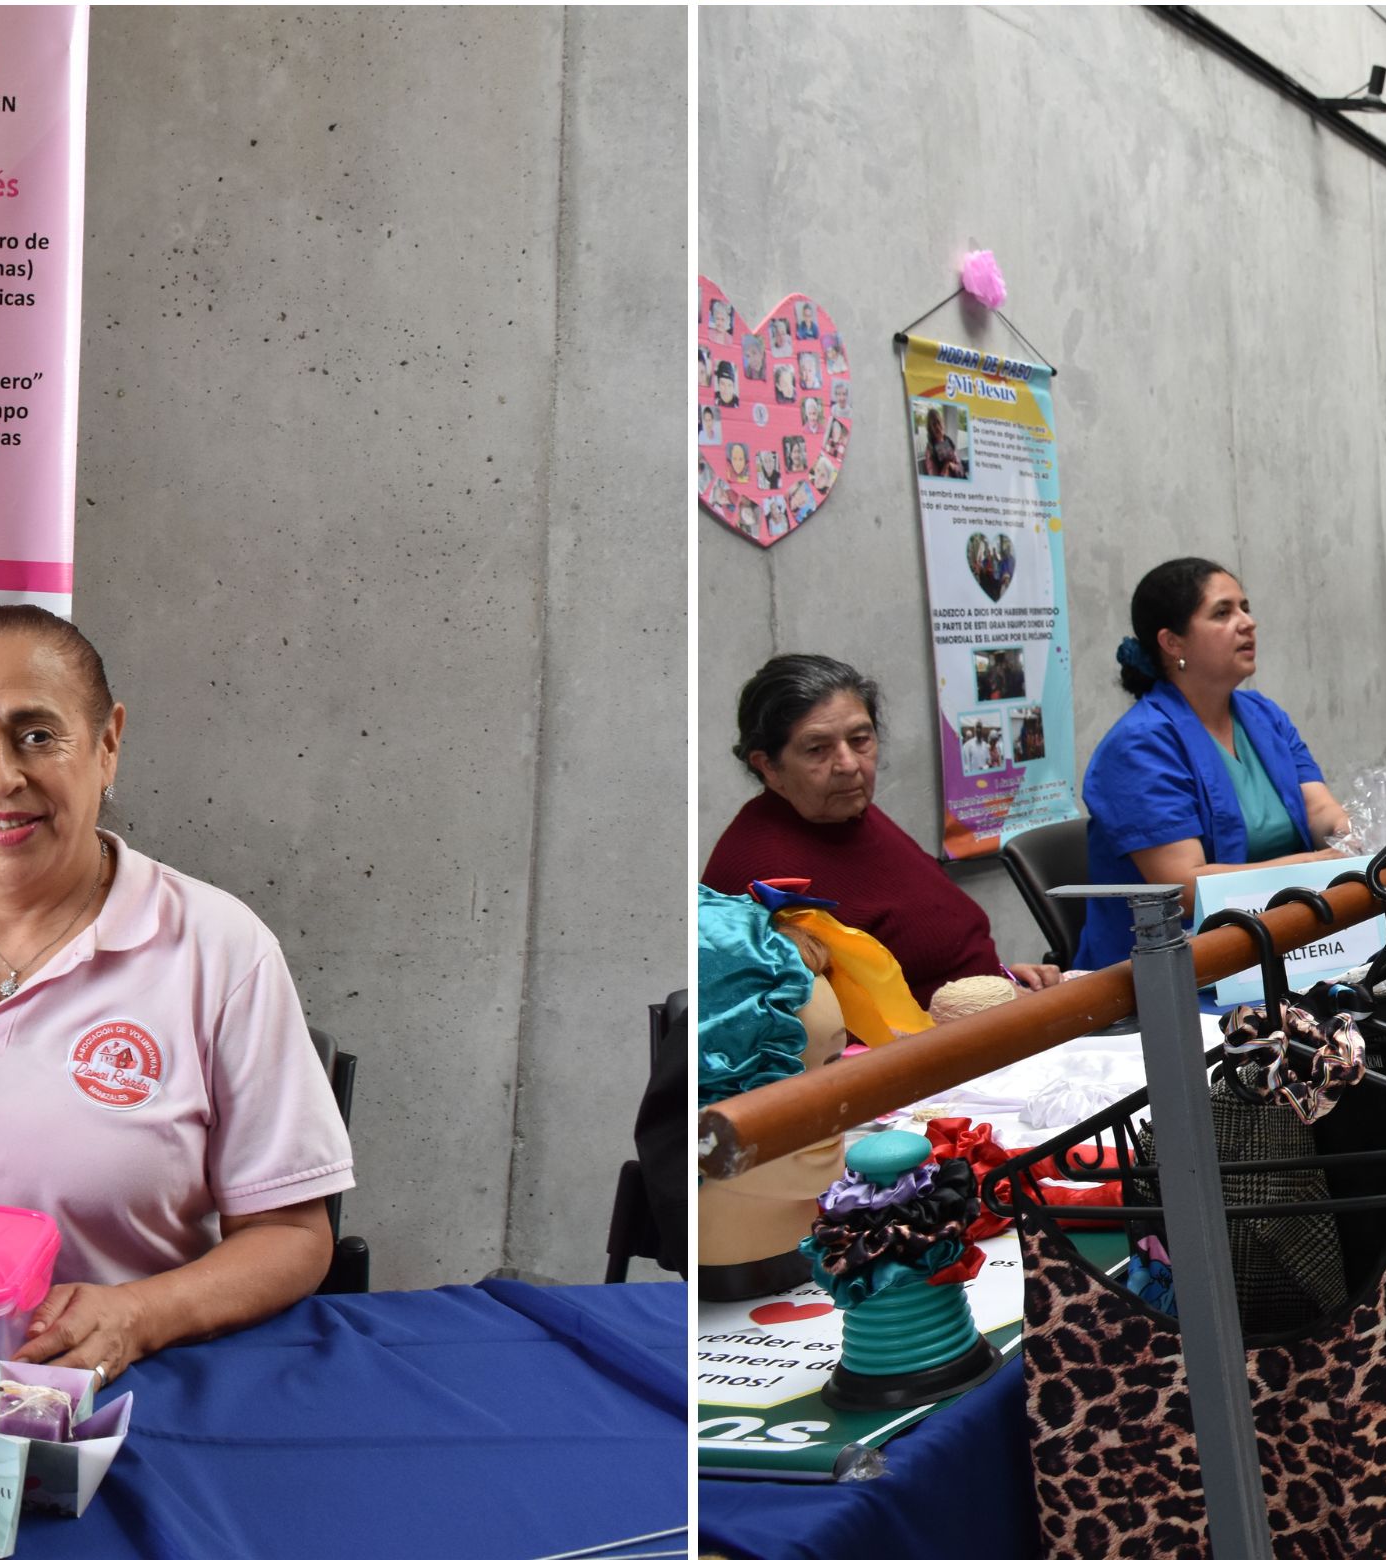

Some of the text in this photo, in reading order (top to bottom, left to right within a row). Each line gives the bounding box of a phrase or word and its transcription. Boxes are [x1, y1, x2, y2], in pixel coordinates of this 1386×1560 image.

[24, 233, 50, 251] de
[937, 343, 1033, 381] HOGAR DE PASO
[116, 1026, 126, 1034] DE
[129, 1029, 158, 1075] VOLUNTARIAS
